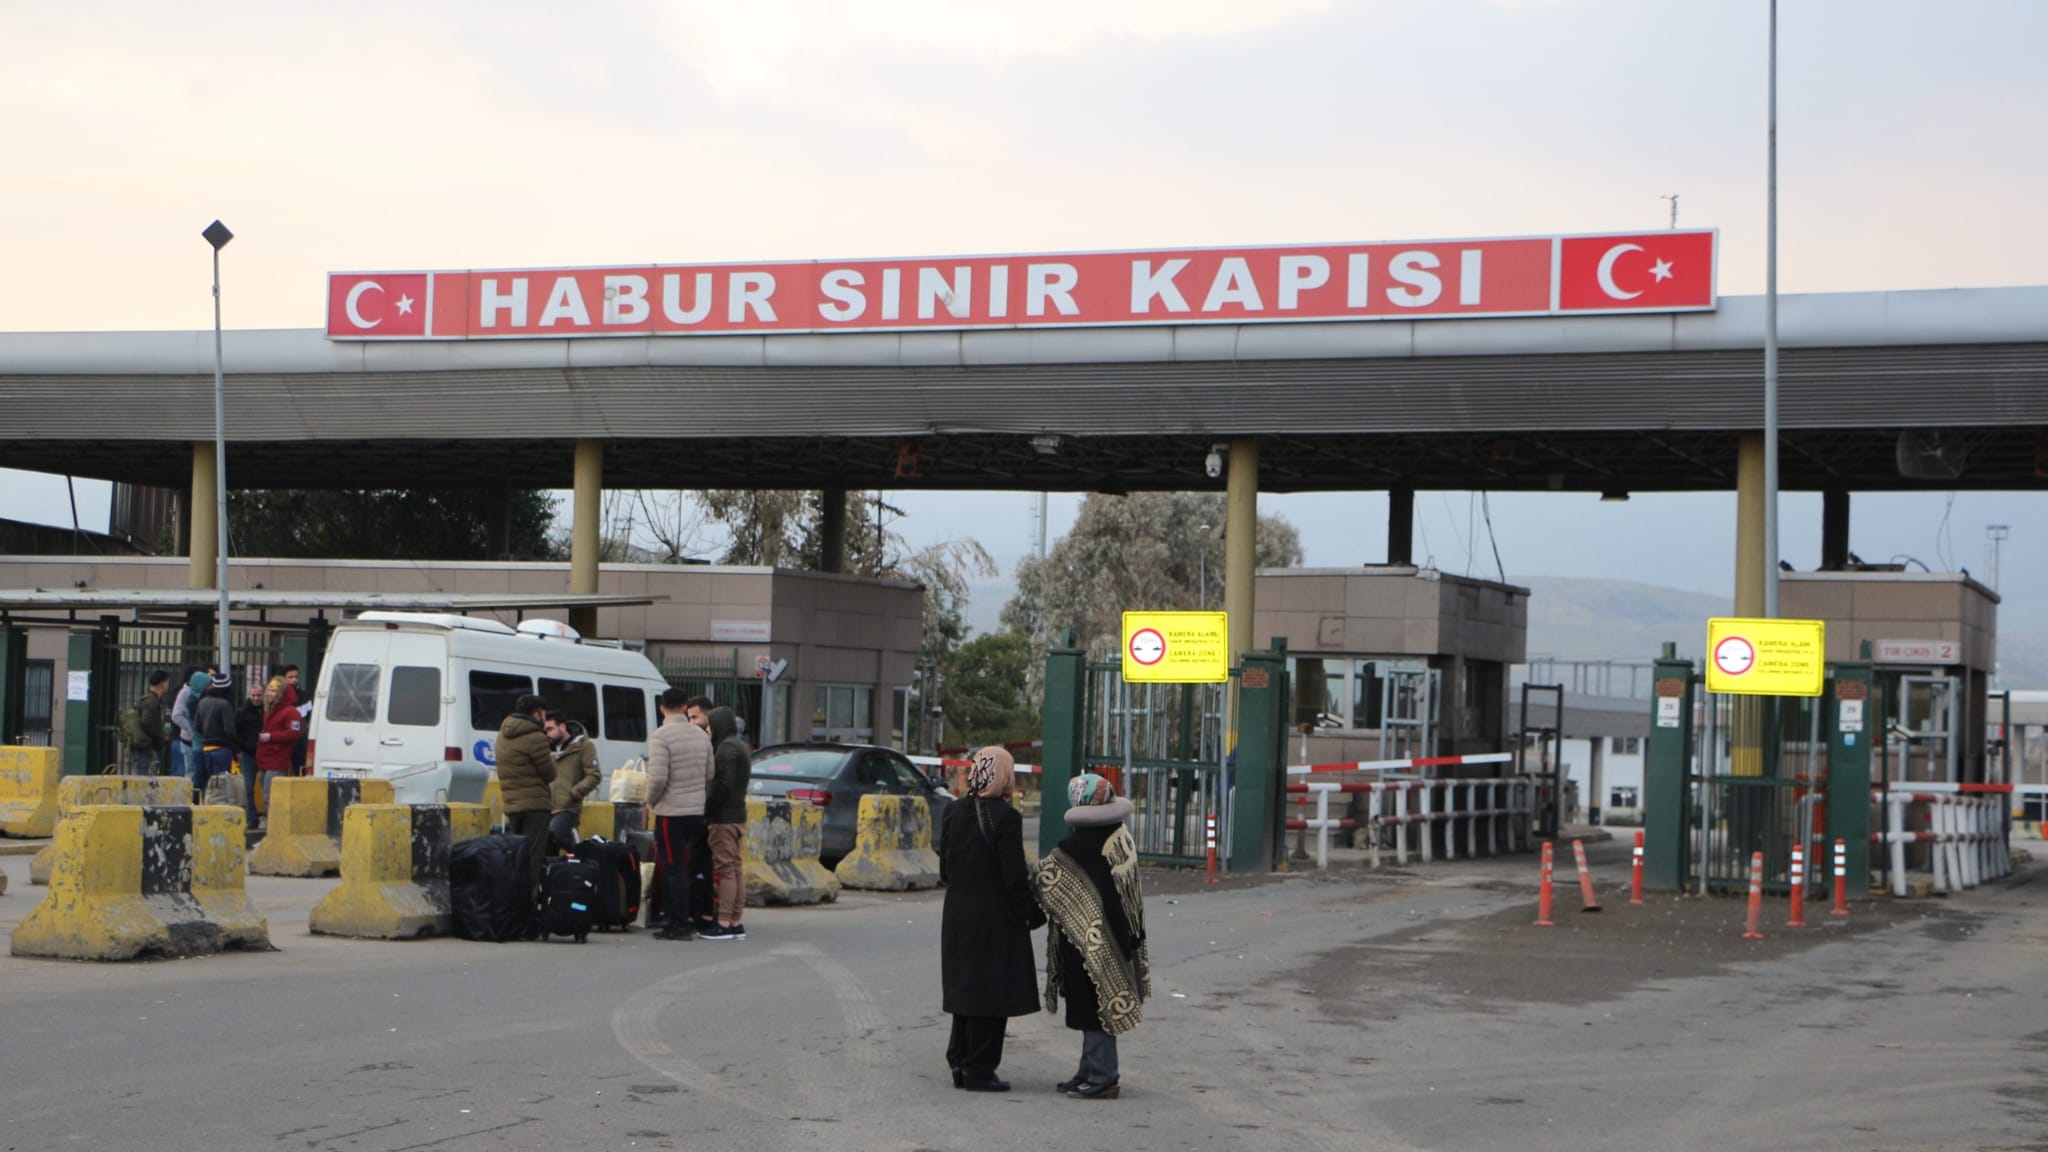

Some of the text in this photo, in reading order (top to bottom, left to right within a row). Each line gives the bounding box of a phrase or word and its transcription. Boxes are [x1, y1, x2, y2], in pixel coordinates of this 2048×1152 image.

[480, 249, 1482, 328] HABUR SINIR KAPISI
[1941, 645, 1952, 659] 2
